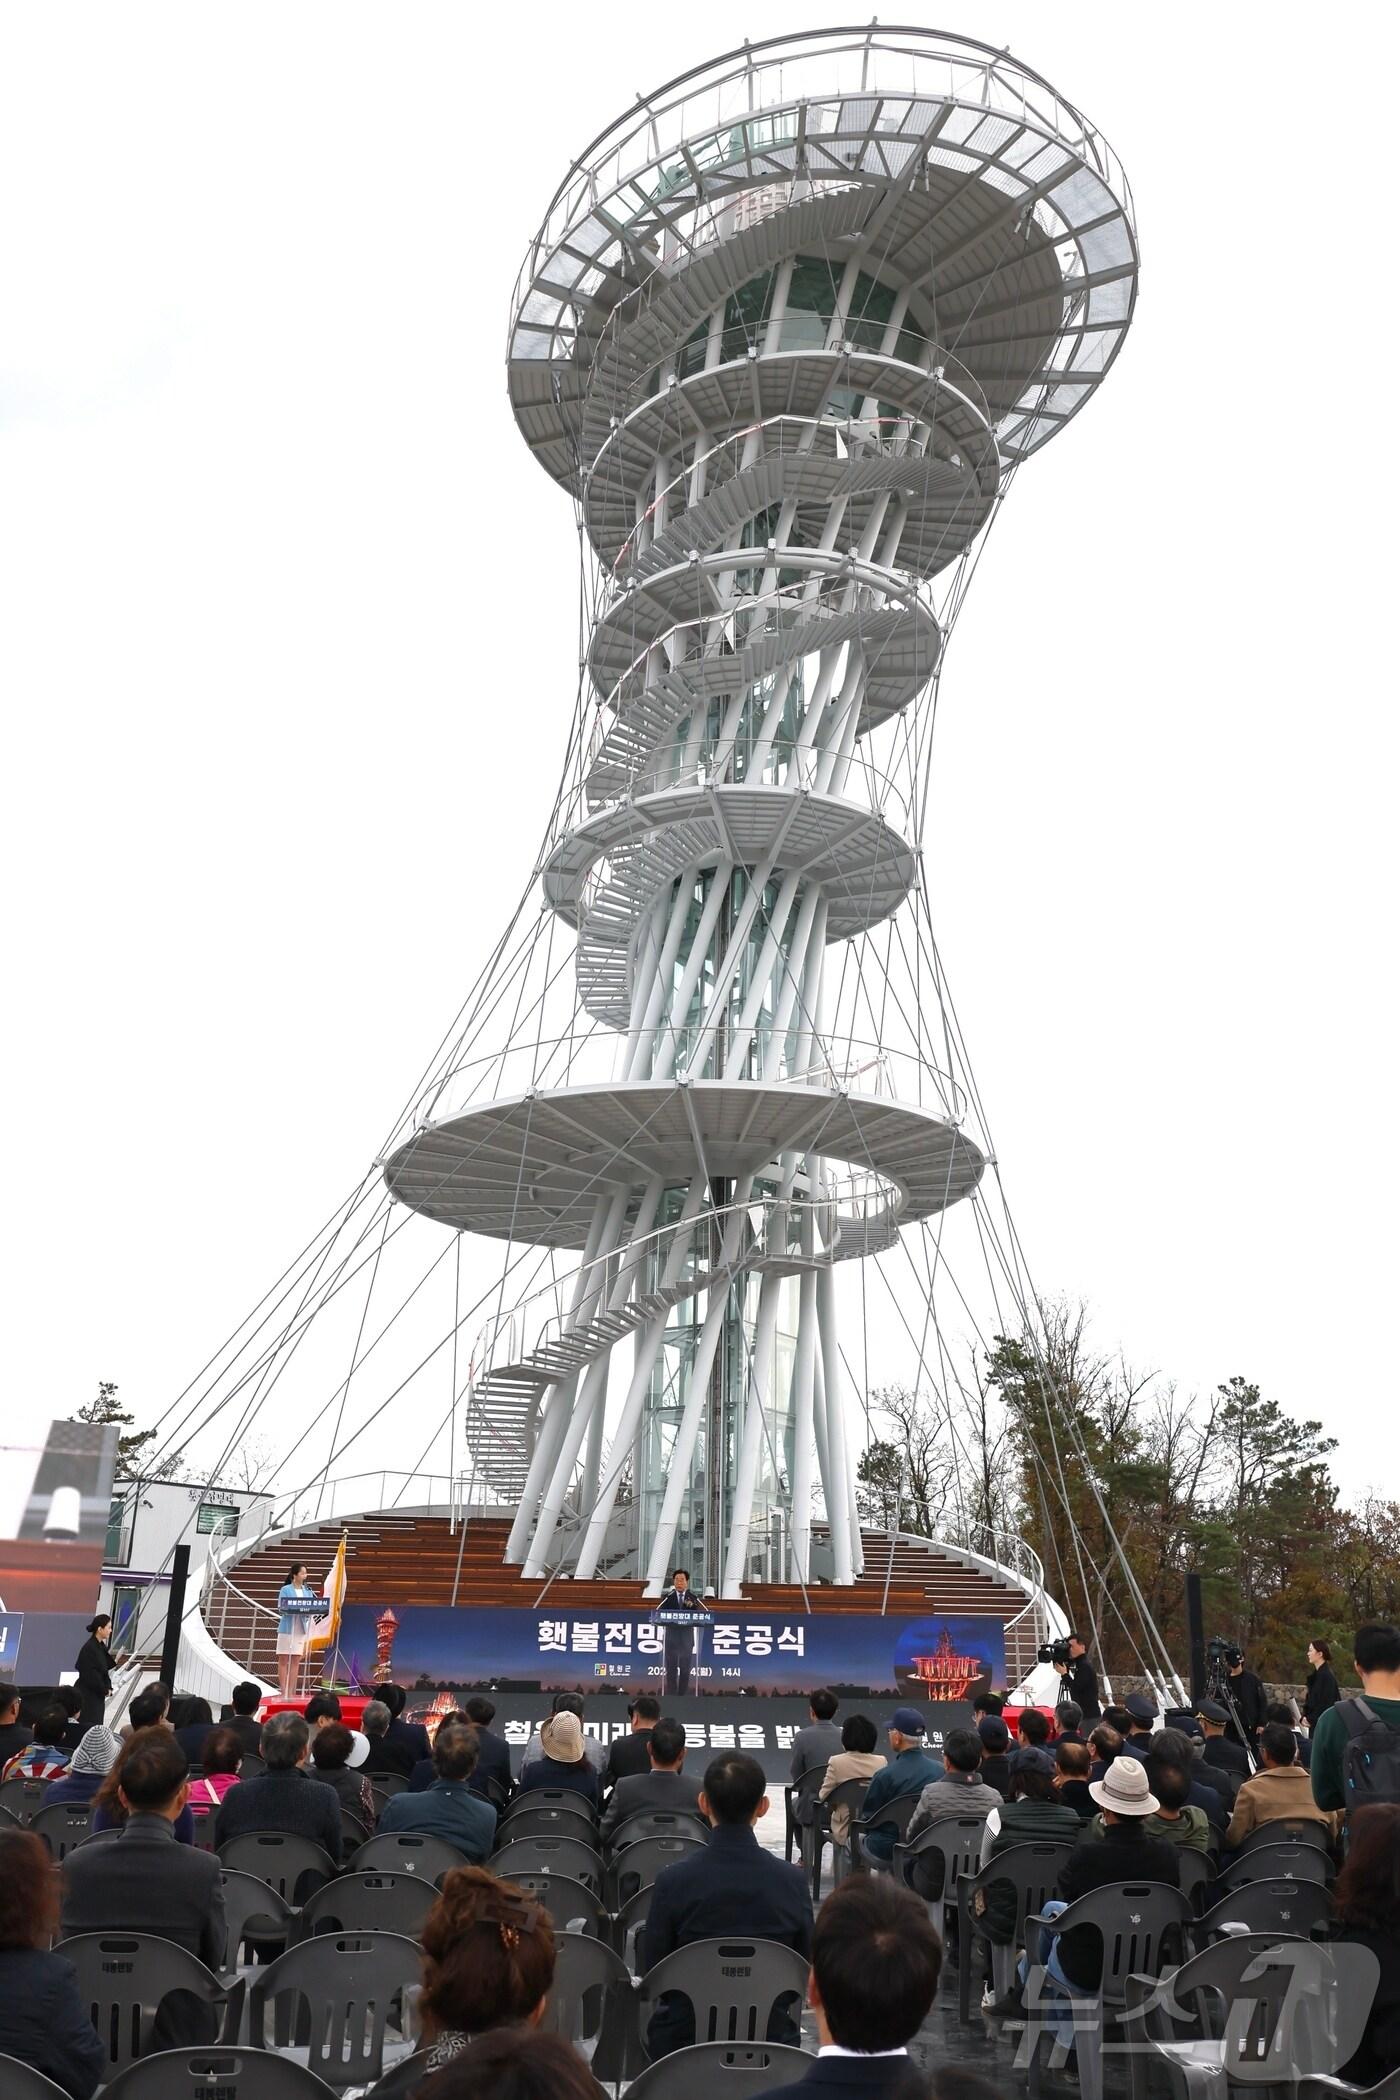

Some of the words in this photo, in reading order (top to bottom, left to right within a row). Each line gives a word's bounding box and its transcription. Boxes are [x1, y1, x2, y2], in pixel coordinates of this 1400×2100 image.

[538, 1620, 698, 1655] 횃불전망
[712, 1624, 805, 1657] 준공식
[721, 1667, 741, 1677] 14시
